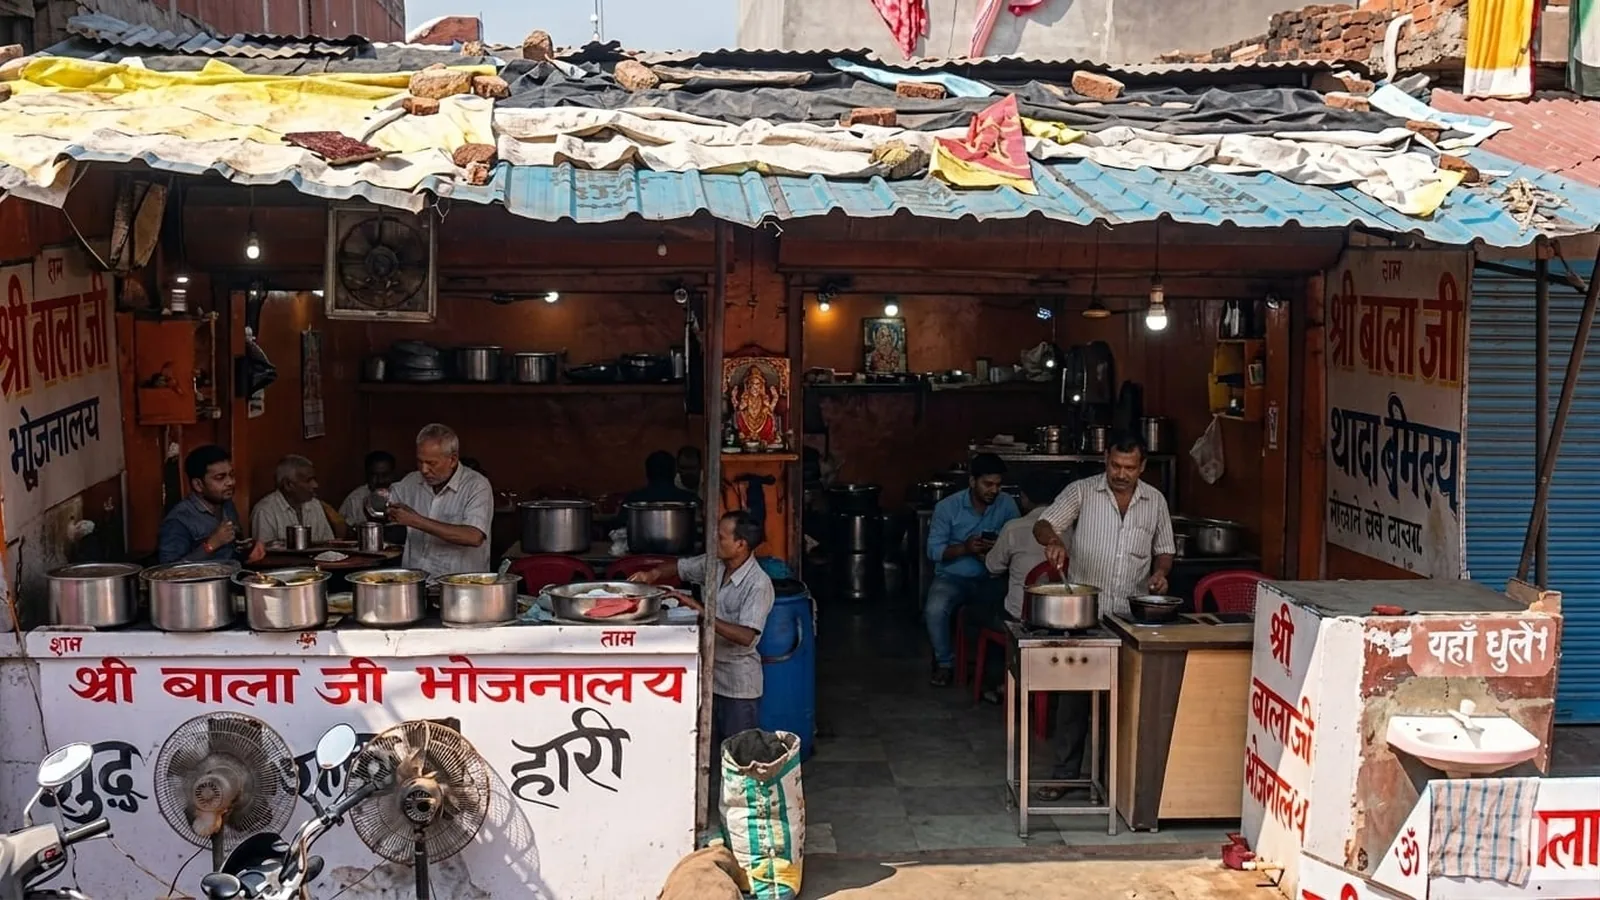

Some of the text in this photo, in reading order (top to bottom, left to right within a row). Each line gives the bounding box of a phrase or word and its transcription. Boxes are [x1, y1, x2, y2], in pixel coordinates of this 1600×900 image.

[1270, 603, 1294, 669] श्री
[1428, 621, 1478, 668] यहाँ
[68, 655, 688, 706] श्री बाला जी भोजनालय
[511, 707, 632, 810] हारी
